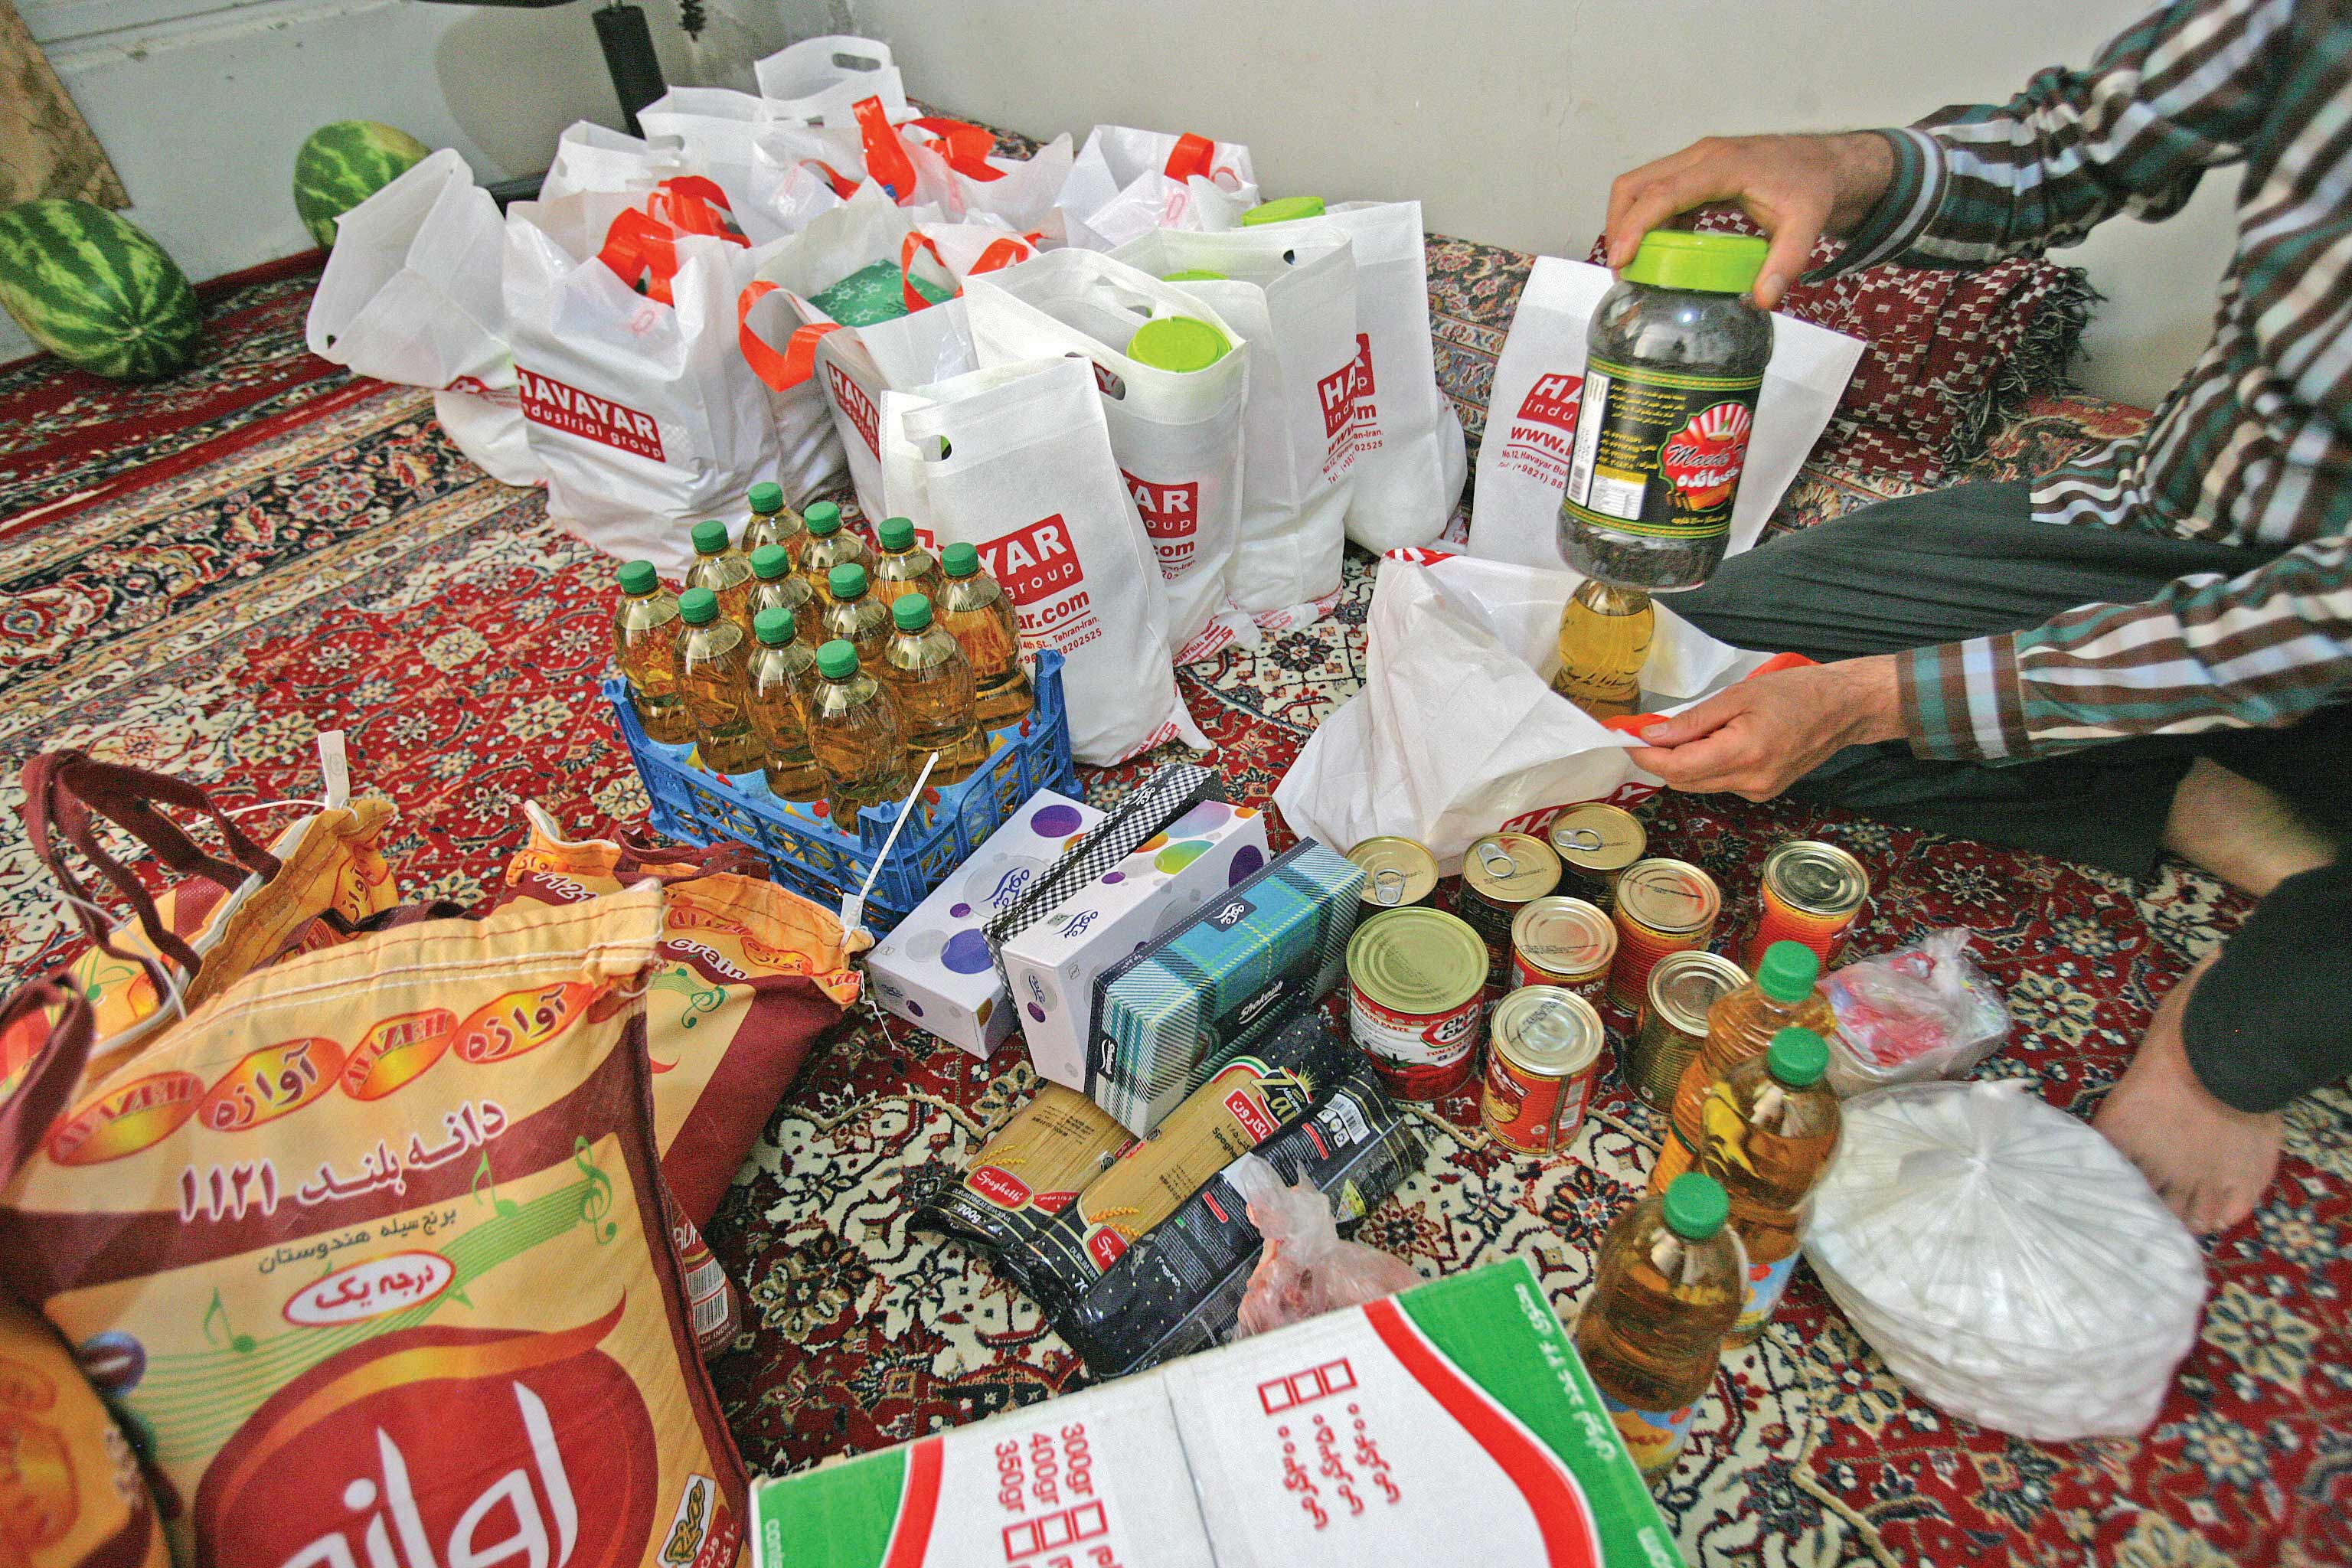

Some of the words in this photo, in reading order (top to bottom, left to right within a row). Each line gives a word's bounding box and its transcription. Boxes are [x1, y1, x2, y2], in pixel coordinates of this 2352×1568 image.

[522, 403, 603, 437] ndustrial
[610, 432, 662, 459] group
[1353, 403, 1377, 420] m
[1526, 400, 1574, 421] indu
[1521, 450, 1552, 469] Havayar
[1128, 478, 1191, 515] AR
[667, 938, 747, 981] Grain
[466, 983, 568, 1062] آوازه
[214, 1040, 319, 1130] آوازه
[407, 1100, 508, 1170] دانه
[297, 1141, 408, 1204] بلند
[975, 1171, 1024, 1202] Spaghetti
[423, 1207, 458, 1236] برنج
[956, 1204, 982, 1224] 700g
[257, 1229, 371, 1276] هندوستان
[315, 1274, 371, 1309] یک
[377, 1263, 435, 1297] درجه
[995, 1439, 1026, 1513] 350gr
[1029, 1432, 1060, 1506] 400gr
[1060, 1422, 1094, 1496] 300gr
